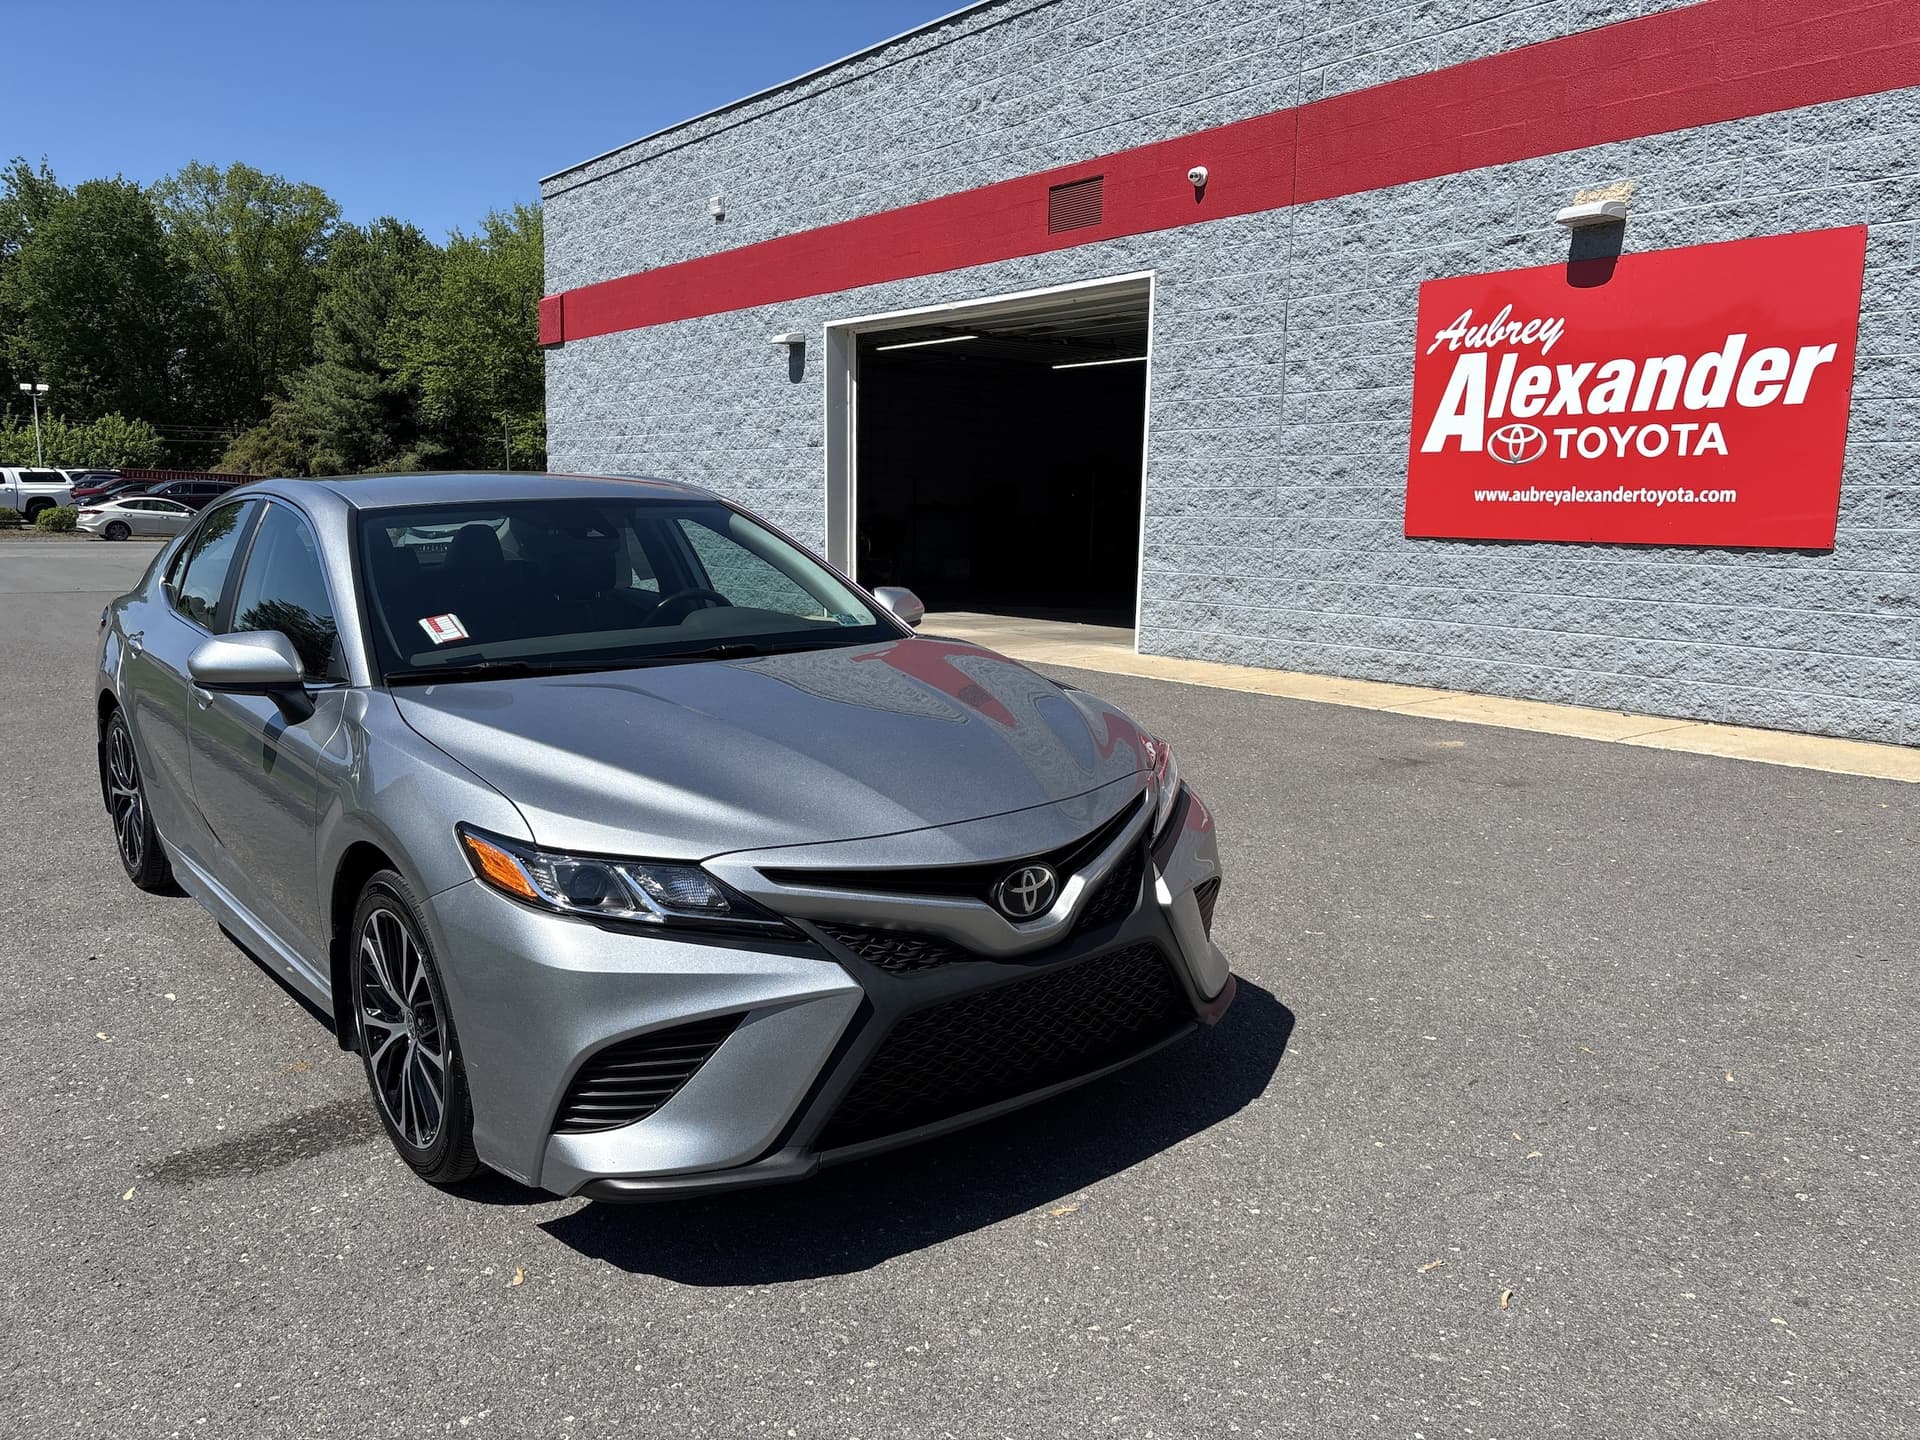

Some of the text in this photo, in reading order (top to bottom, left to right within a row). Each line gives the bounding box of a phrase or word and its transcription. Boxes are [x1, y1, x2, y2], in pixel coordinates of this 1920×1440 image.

[1427, 304, 1565, 355] Aubrey
[1421, 334, 1837, 452] Alexander
[1553, 423, 1729, 459] TOYOTA
[1474, 486, 1737, 506] www.aubreyalexandertoyota.com
